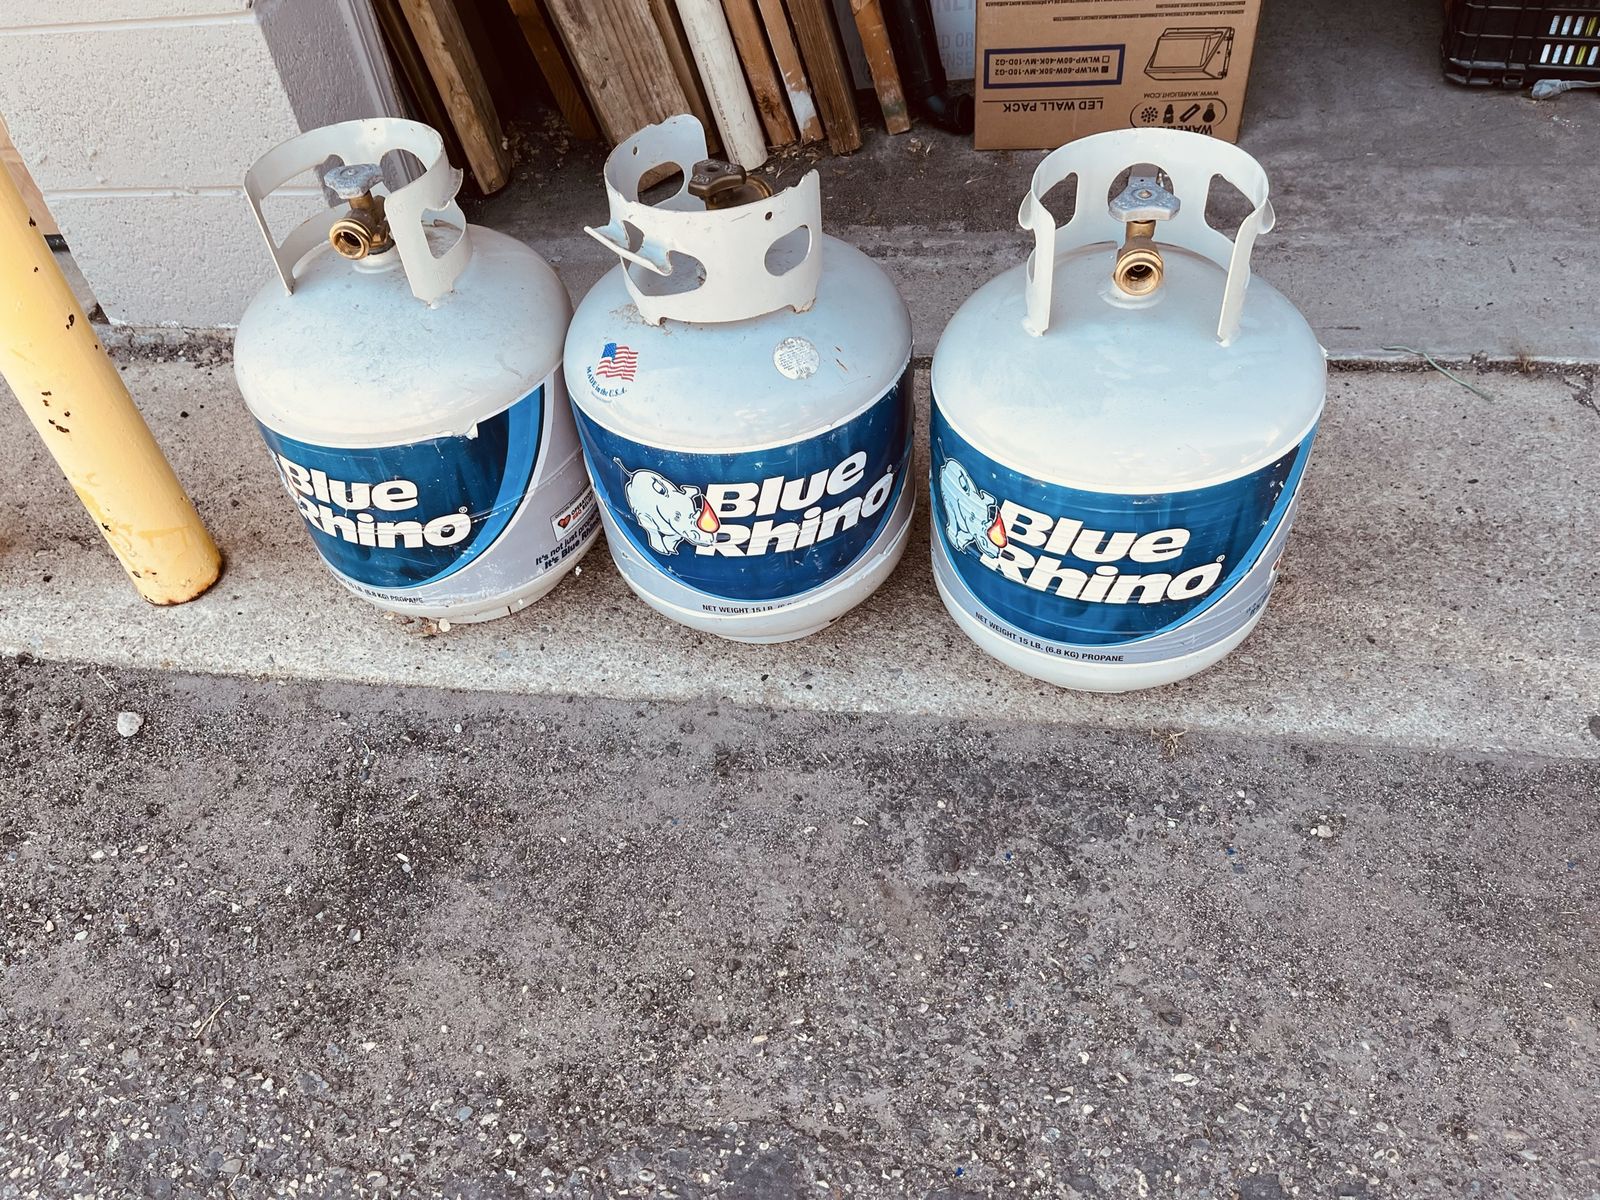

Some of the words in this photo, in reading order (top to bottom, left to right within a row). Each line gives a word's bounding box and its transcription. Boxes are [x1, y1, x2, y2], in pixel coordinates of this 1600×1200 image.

[1003, 102, 1037, 113] PACK
[1040, 101, 1076, 112] WALL
[1078, 100, 1104, 111] LED
[277, 453, 418, 511] Blue
[706, 451, 867, 518] Blue
[1000, 499, 1191, 563] Blue
[536, 554, 549, 566] It's
[551, 543, 563, 556] not
[565, 532, 577, 547] just
[545, 556, 559, 569] It's
[561, 540, 580, 558] Blue
[702, 604, 717, 612] NET
[975, 611, 987, 624] NET
[989, 621, 1017, 640] WEIGHT
[1019, 636, 1029, 645] 15
[1030, 640, 1043, 651] LB.
[1045, 645, 1062, 655] (6.8
[1063, 650, 1079, 660] KG)
[1081, 652, 1124, 662] PROPANE
